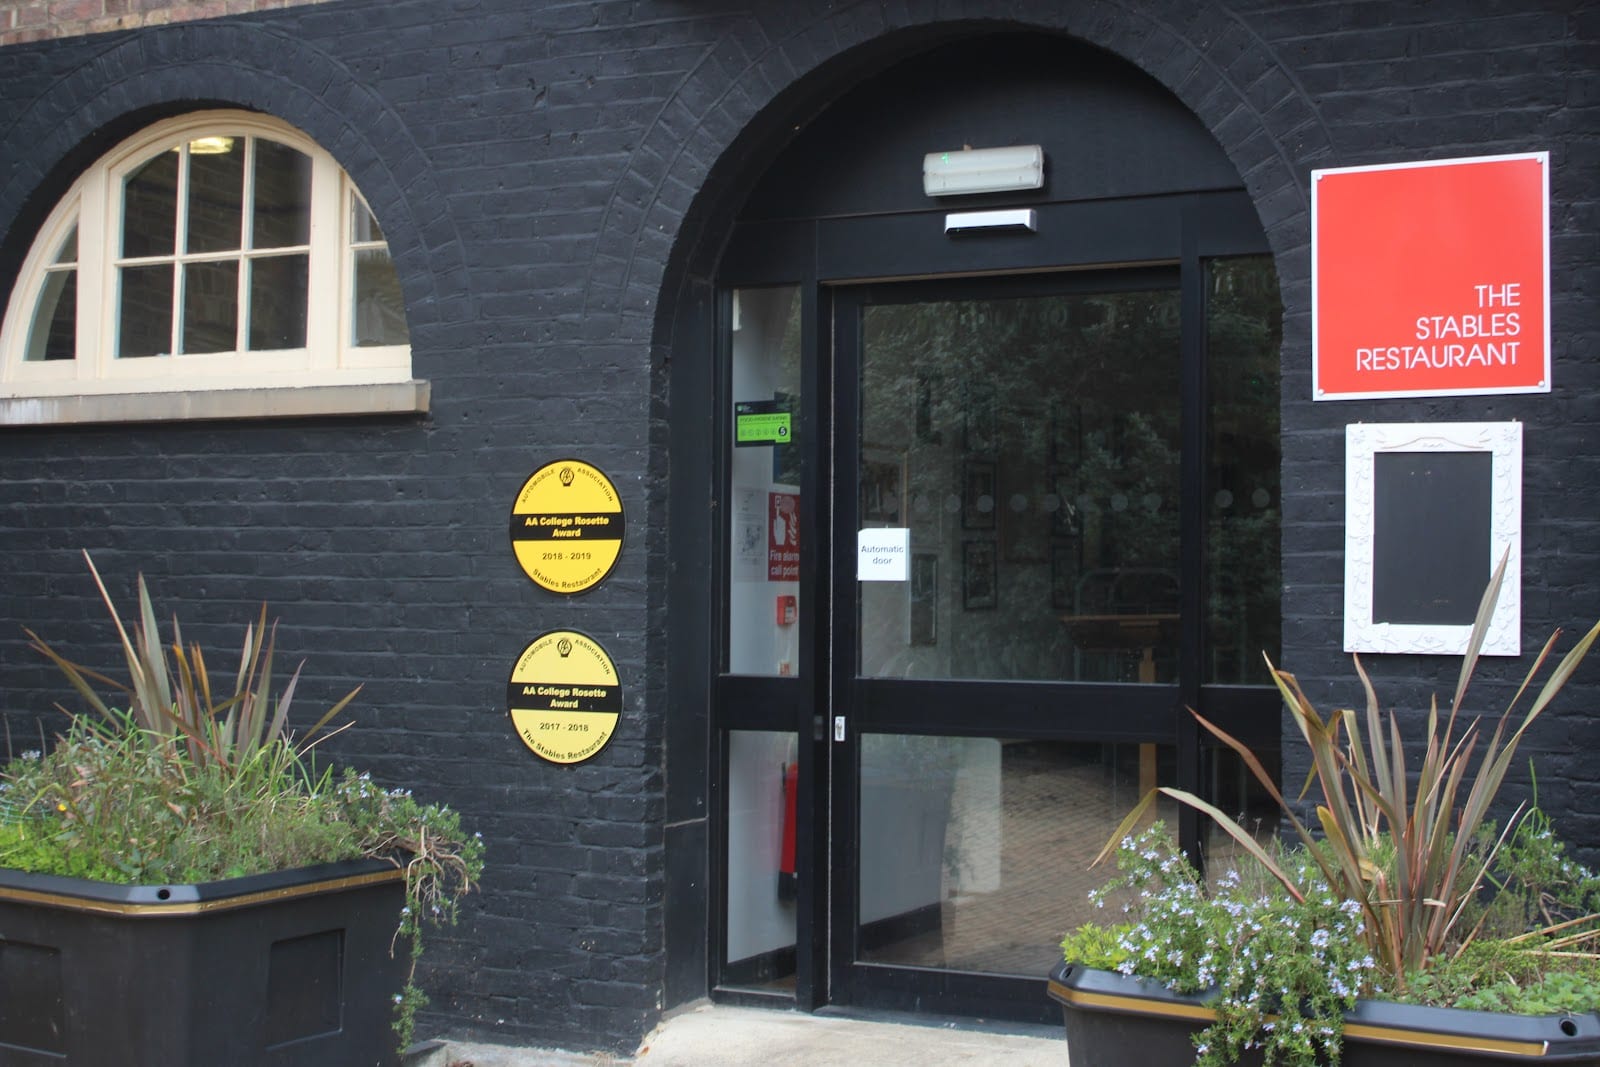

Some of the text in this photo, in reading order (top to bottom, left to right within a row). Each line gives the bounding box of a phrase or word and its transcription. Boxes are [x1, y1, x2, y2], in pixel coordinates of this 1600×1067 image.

[1474, 283, 1521, 308] THE
[1415, 312, 1521, 340] STABLES
[1356, 341, 1521, 371] RESTAURANT
[522, 468, 555, 503] AUTOMOBILE
[577, 467, 613, 502] ASSOCIATION
[525, 516, 609, 527] AA College Rosette
[552, 528, 581, 537] Award
[542, 552, 563, 561] 2018
[571, 552, 591, 560] 2019
[770, 549, 800, 561] Fire alarm
[861, 545, 904, 553] Automatic
[872, 557, 893, 565] door
[533, 568, 602, 589] Stables Restaurant
[771, 564, 799, 579] call point
[520, 639, 553, 672] AUTOMOBILE
[575, 639, 611, 675] ASSOCIATION
[523, 686, 607, 698] AA College Rosette
[550, 699, 579, 709] Award
[540, 722, 561, 731] 2017
[568, 723, 589, 732] 2018
[523, 728, 607, 760] The Stables Restaurant
